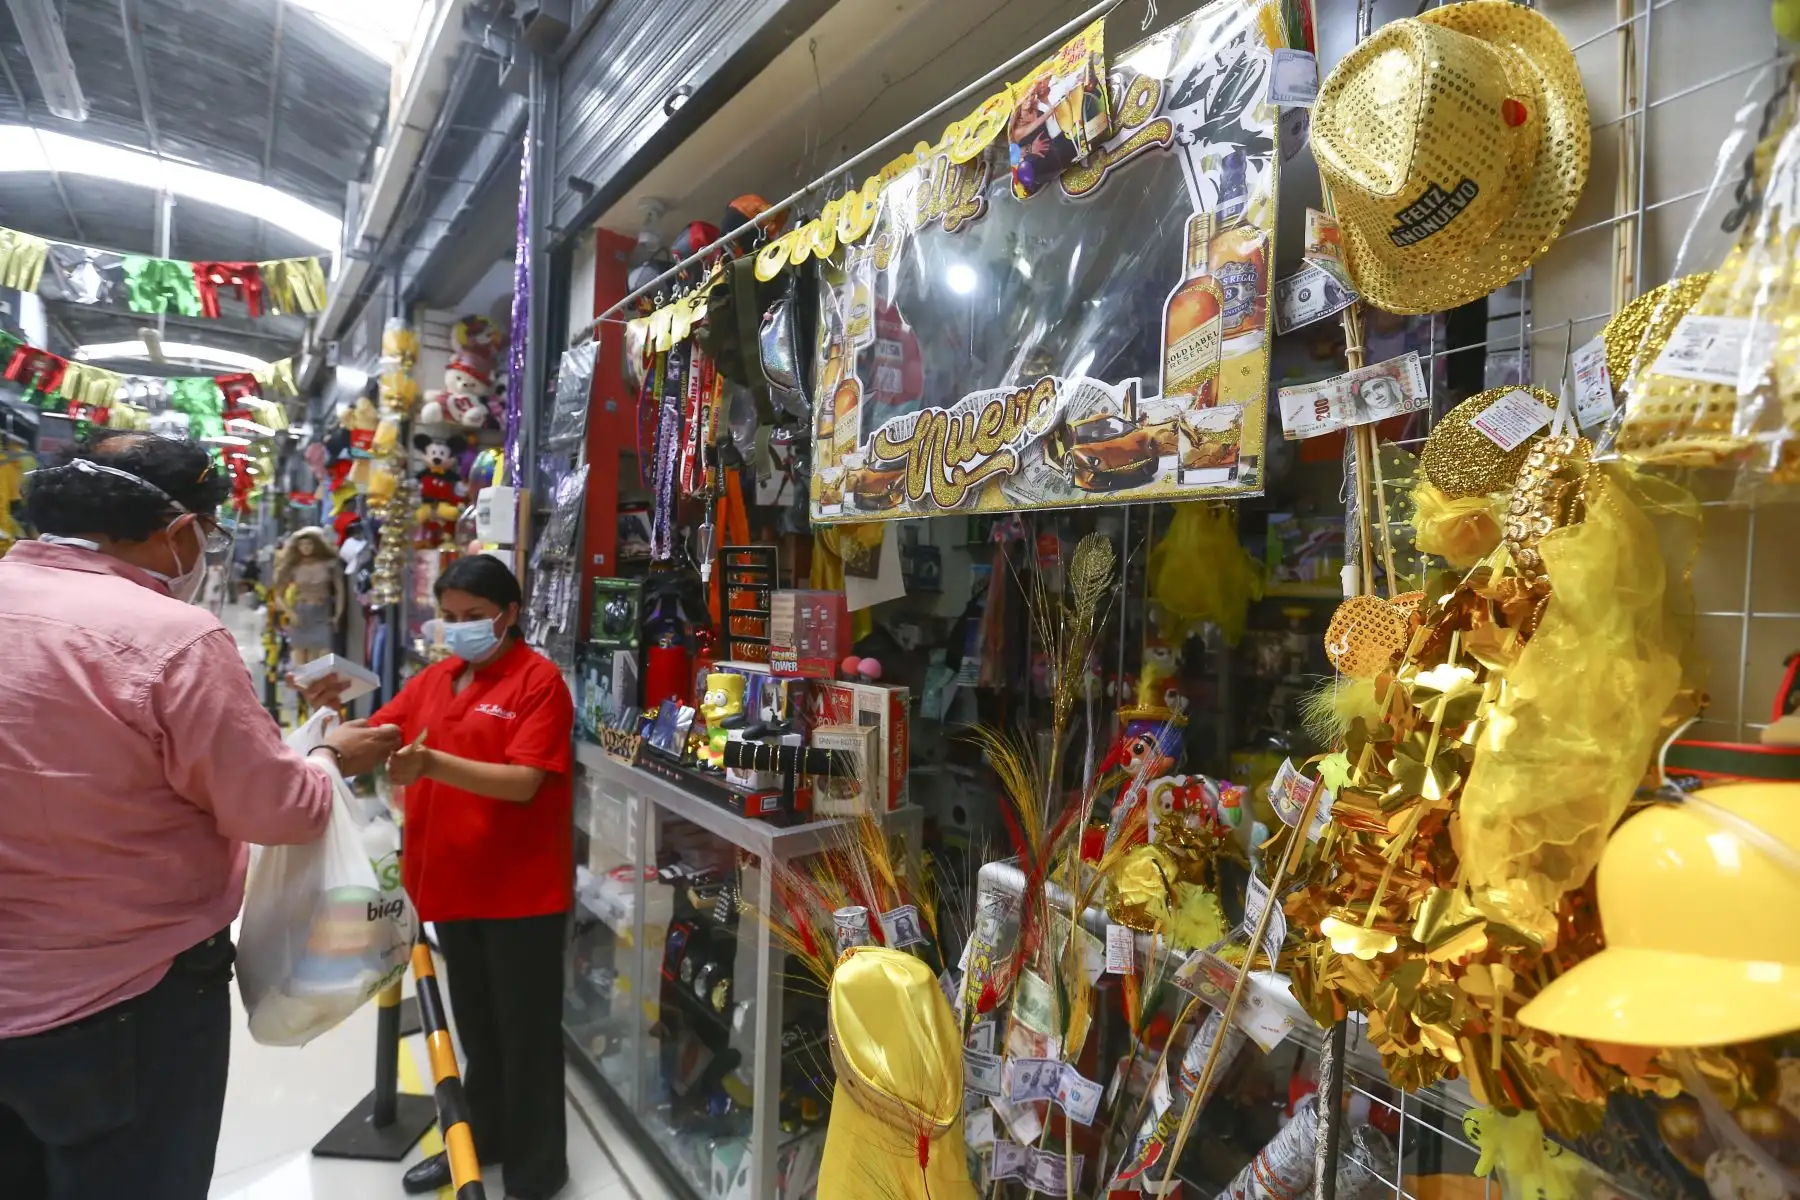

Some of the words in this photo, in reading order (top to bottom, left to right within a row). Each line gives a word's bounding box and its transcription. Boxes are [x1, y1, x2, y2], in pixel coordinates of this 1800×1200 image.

[1400, 187, 1447, 225] FELIZ
[1230, 273, 1256, 284] REGAL
[1189, 330, 1220, 351] LABEL
[1169, 340, 1217, 370] RESERVE
[1314, 398, 1331, 422] 200
[874, 375, 1057, 507] Nuevo
[771, 660, 798, 672] TOWER
